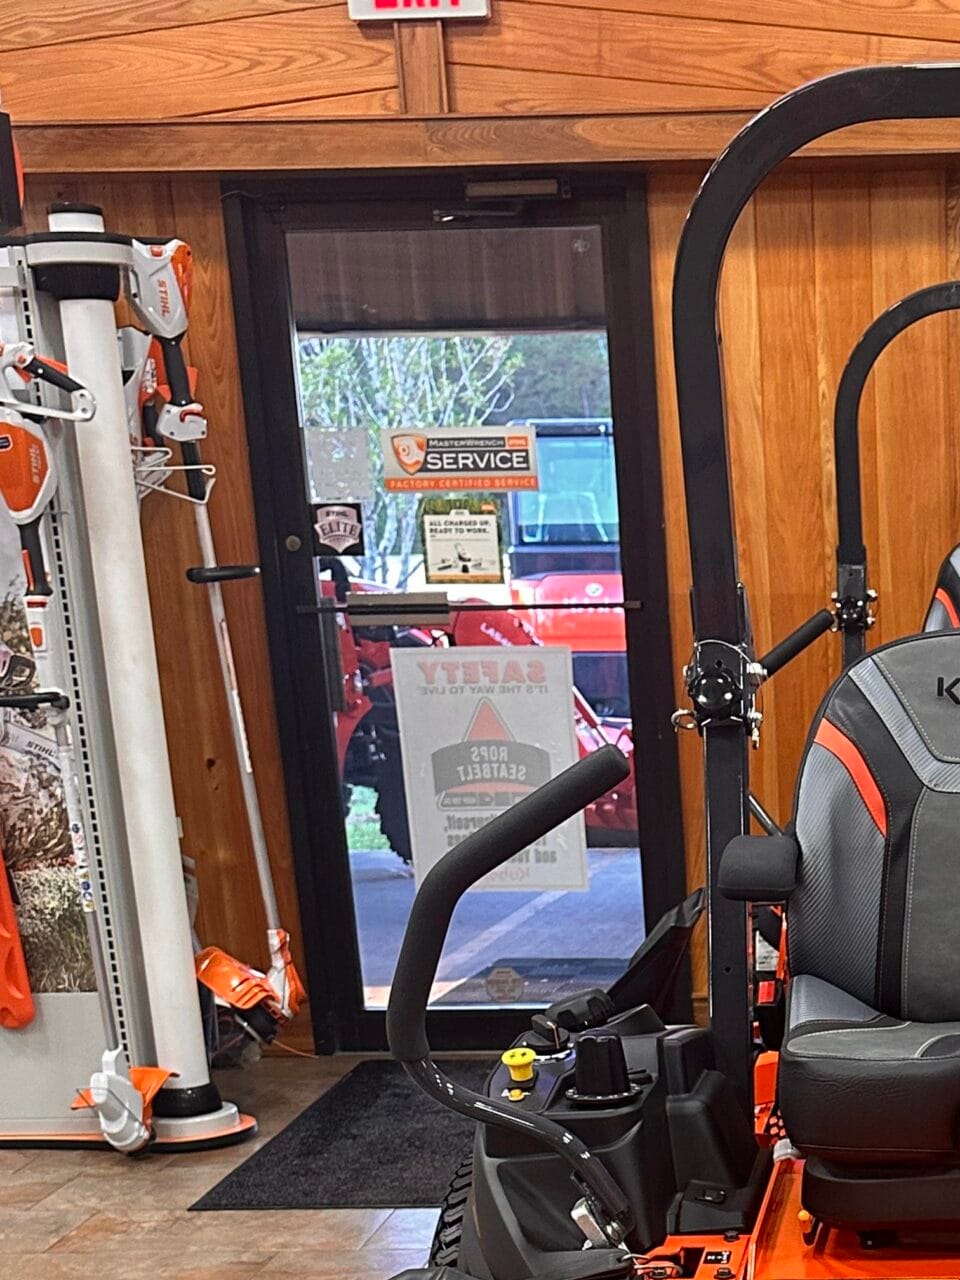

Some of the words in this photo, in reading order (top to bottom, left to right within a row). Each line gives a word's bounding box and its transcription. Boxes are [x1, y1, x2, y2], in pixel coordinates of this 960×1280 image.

[157, 279, 171, 318] STIHL
[426, 452, 528, 470] SERVICE
[390, 479, 436, 489] FACTORY
[438, 479, 492, 488] CERTIFIED
[494, 478, 536, 487] SERVICE
[319, 521, 359, 537] ELITE
[444, 519, 478, 527] CHARGED
[27, 741, 55, 757] STIHL
